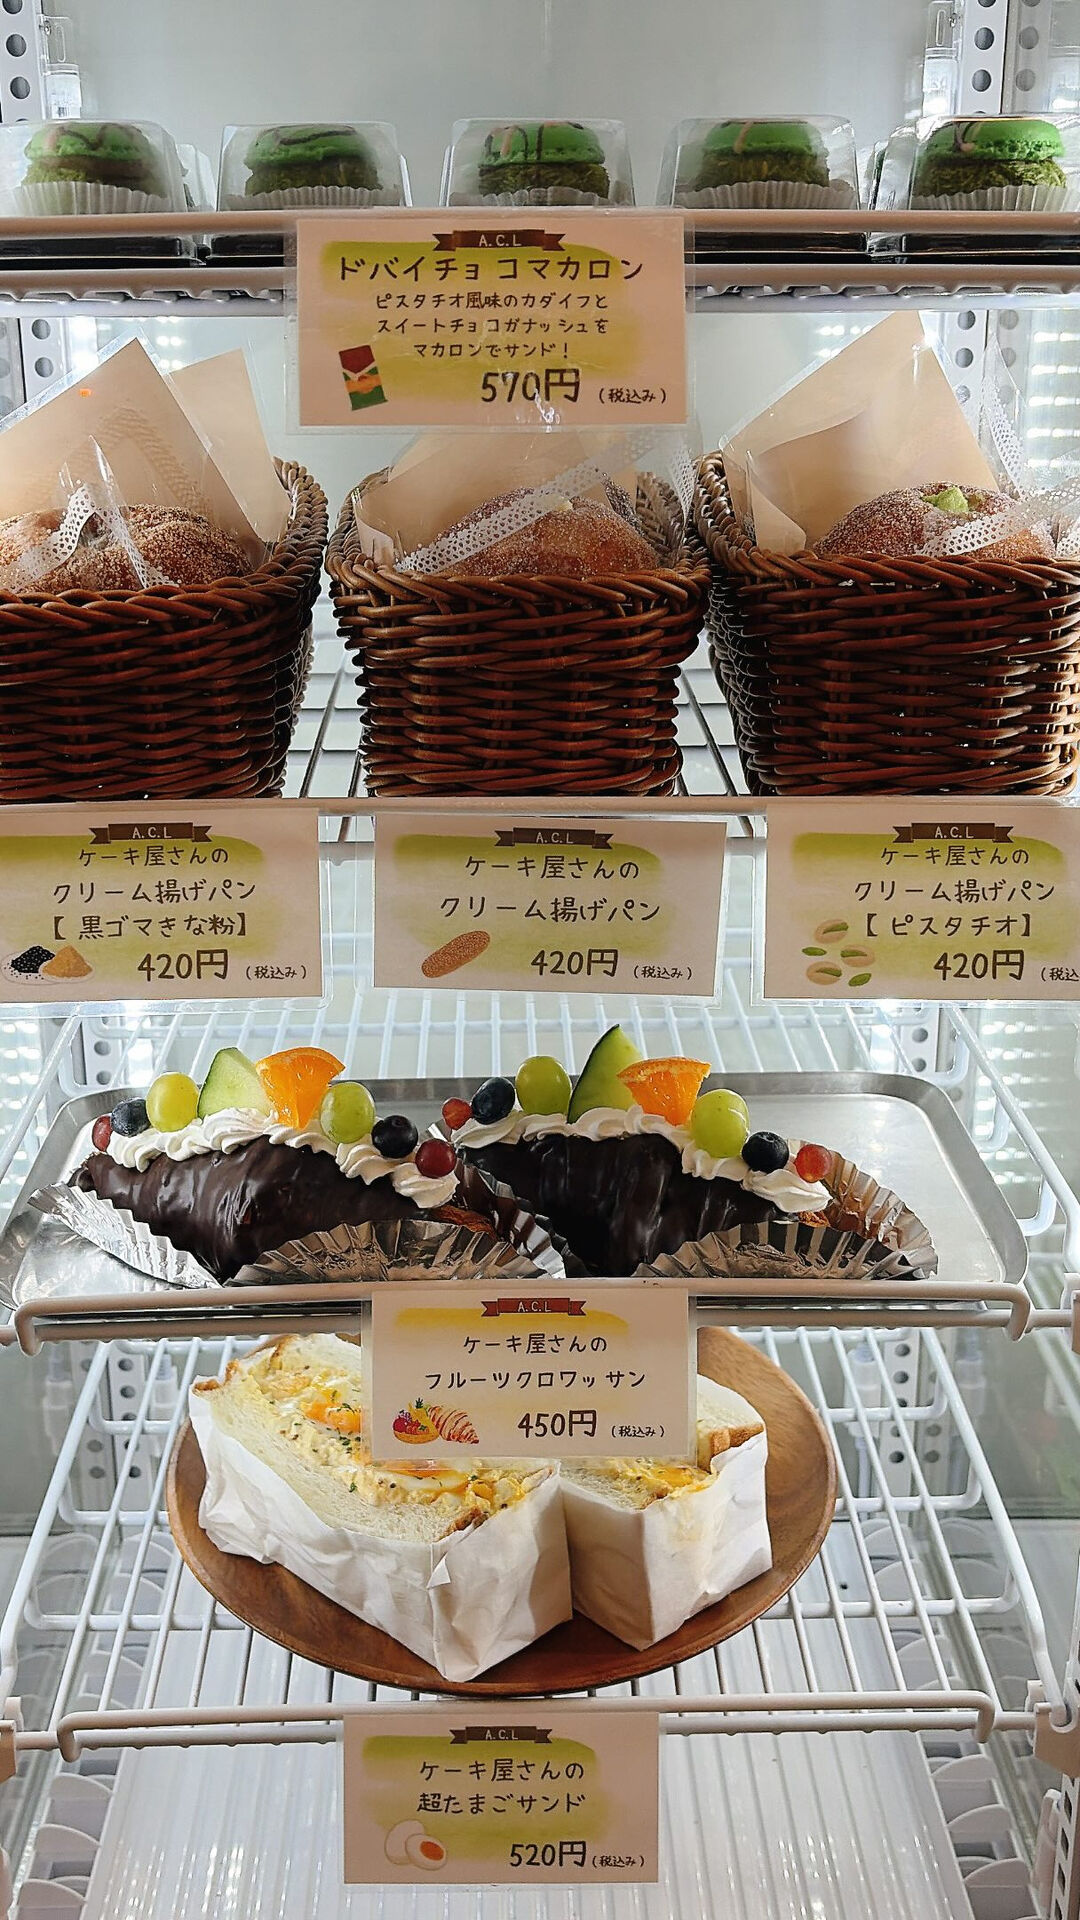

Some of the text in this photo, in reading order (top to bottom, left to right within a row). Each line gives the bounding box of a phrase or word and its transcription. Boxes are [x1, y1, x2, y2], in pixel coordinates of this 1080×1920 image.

[479, 235, 522, 248] A.C.L
[340, 256, 643, 282] ドバイチョコマカロン
[376, 292, 608, 309] ピスタチオ風味のカダイフと
[377, 318, 608, 334] スイートチョコガナッシュを
[413, 342, 569, 359] マカロンでサンド!
[481, 368, 666, 404] 570円 (税込み)
[132, 827, 172, 839] A.C.L
[536, 832, 574, 844] A.C.L
[935, 827, 974, 839] A.C.L
[79, 846, 228, 867] ケーキ屋さんの
[881, 845, 1029, 866] ケーキ屋さんの
[465, 856, 639, 879] ケーキ屋さんの
[53, 879, 256, 904] クリーム揚げパン
[855, 879, 1054, 903] クリーム揚げパン
[440, 897, 660, 923] クリーム揚げパン
[54, 912, 245, 940] 【黒ゴマきな粉】
[867, 913, 1030, 937] 【ピスタチオ】
[138, 949, 307, 981] 420円 (税込み)
[531, 948, 692, 979] 420円 (税込み)
[934, 950, 1024, 981] 420円
[518, 1301, 551, 1312] A.C.L
[463, 1333, 607, 1354] ケーキ屋さんの
[425, 1371, 645, 1389] フルーツクロワッサン
[518, 1410, 664, 1438] 450円 (税込み)
[485, 1729, 518, 1740] A.C.L
[419, 1758, 584, 1782] ケーキ屋さんの
[417, 1792, 585, 1814] 超たまごサンド
[510, 1841, 644, 1868] 520円 (税込み)
